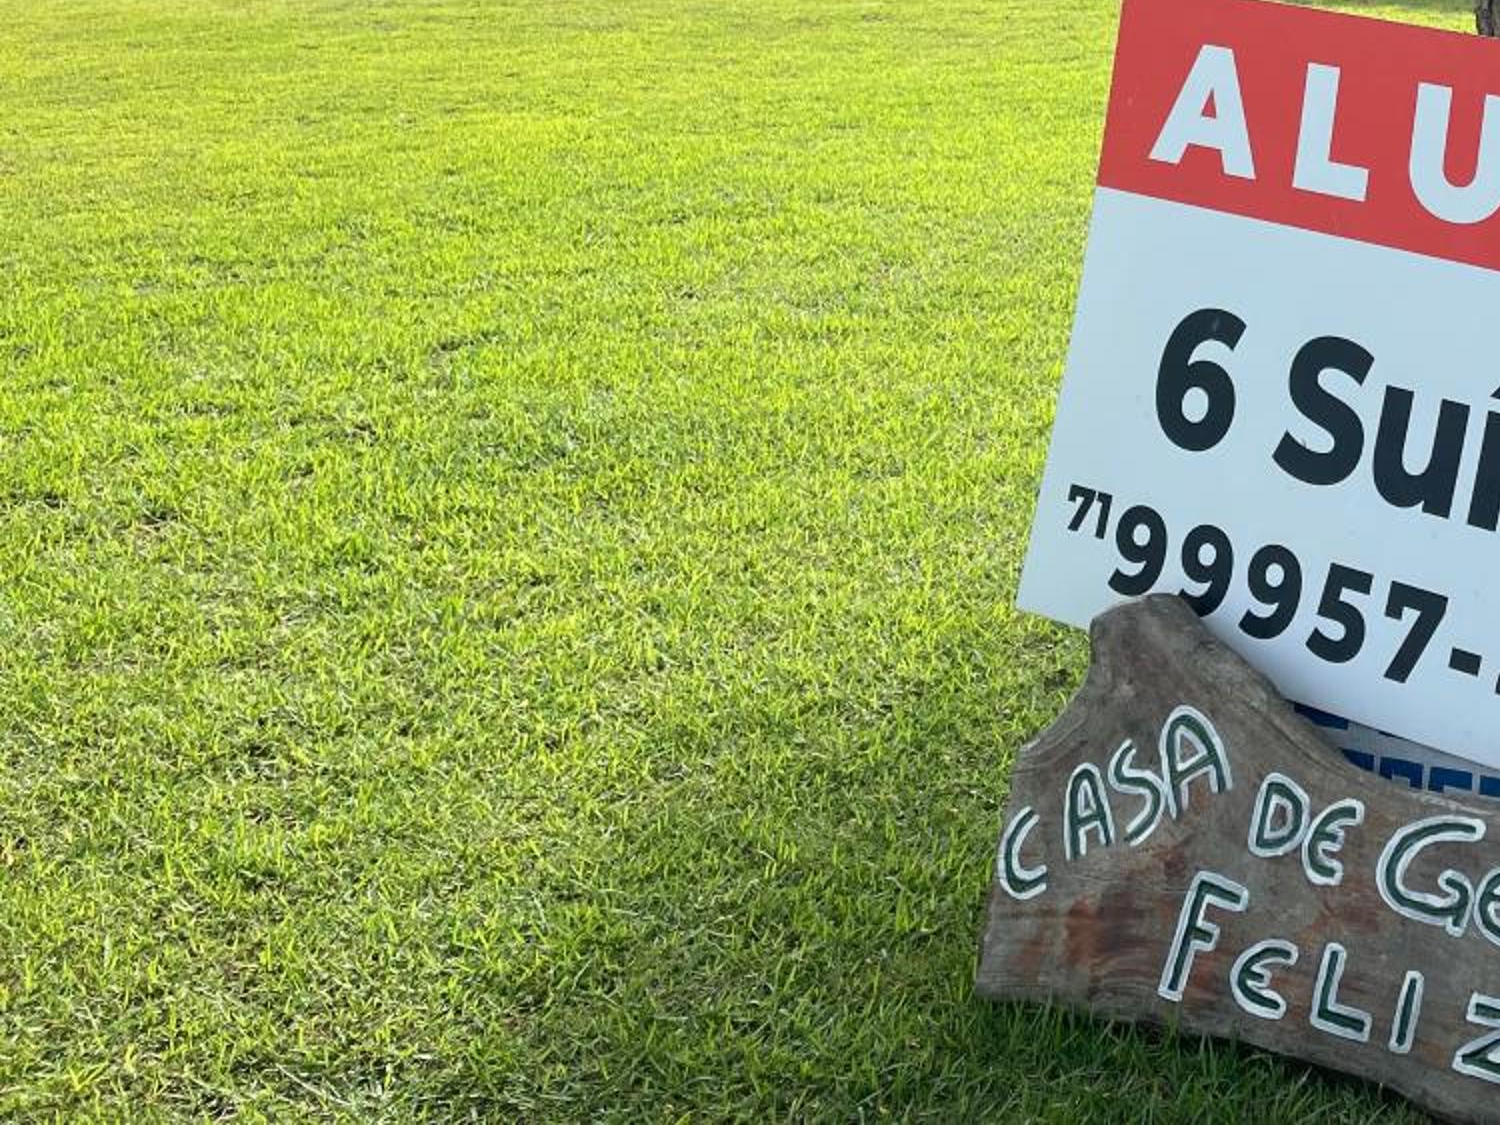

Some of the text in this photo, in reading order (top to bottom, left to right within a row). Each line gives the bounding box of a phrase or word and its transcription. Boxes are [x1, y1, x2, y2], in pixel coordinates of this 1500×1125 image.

[1154, 307, 1248, 452] 6
[998, 704, 1232, 900] CASA
[1248, 771, 1365, 886] DE
